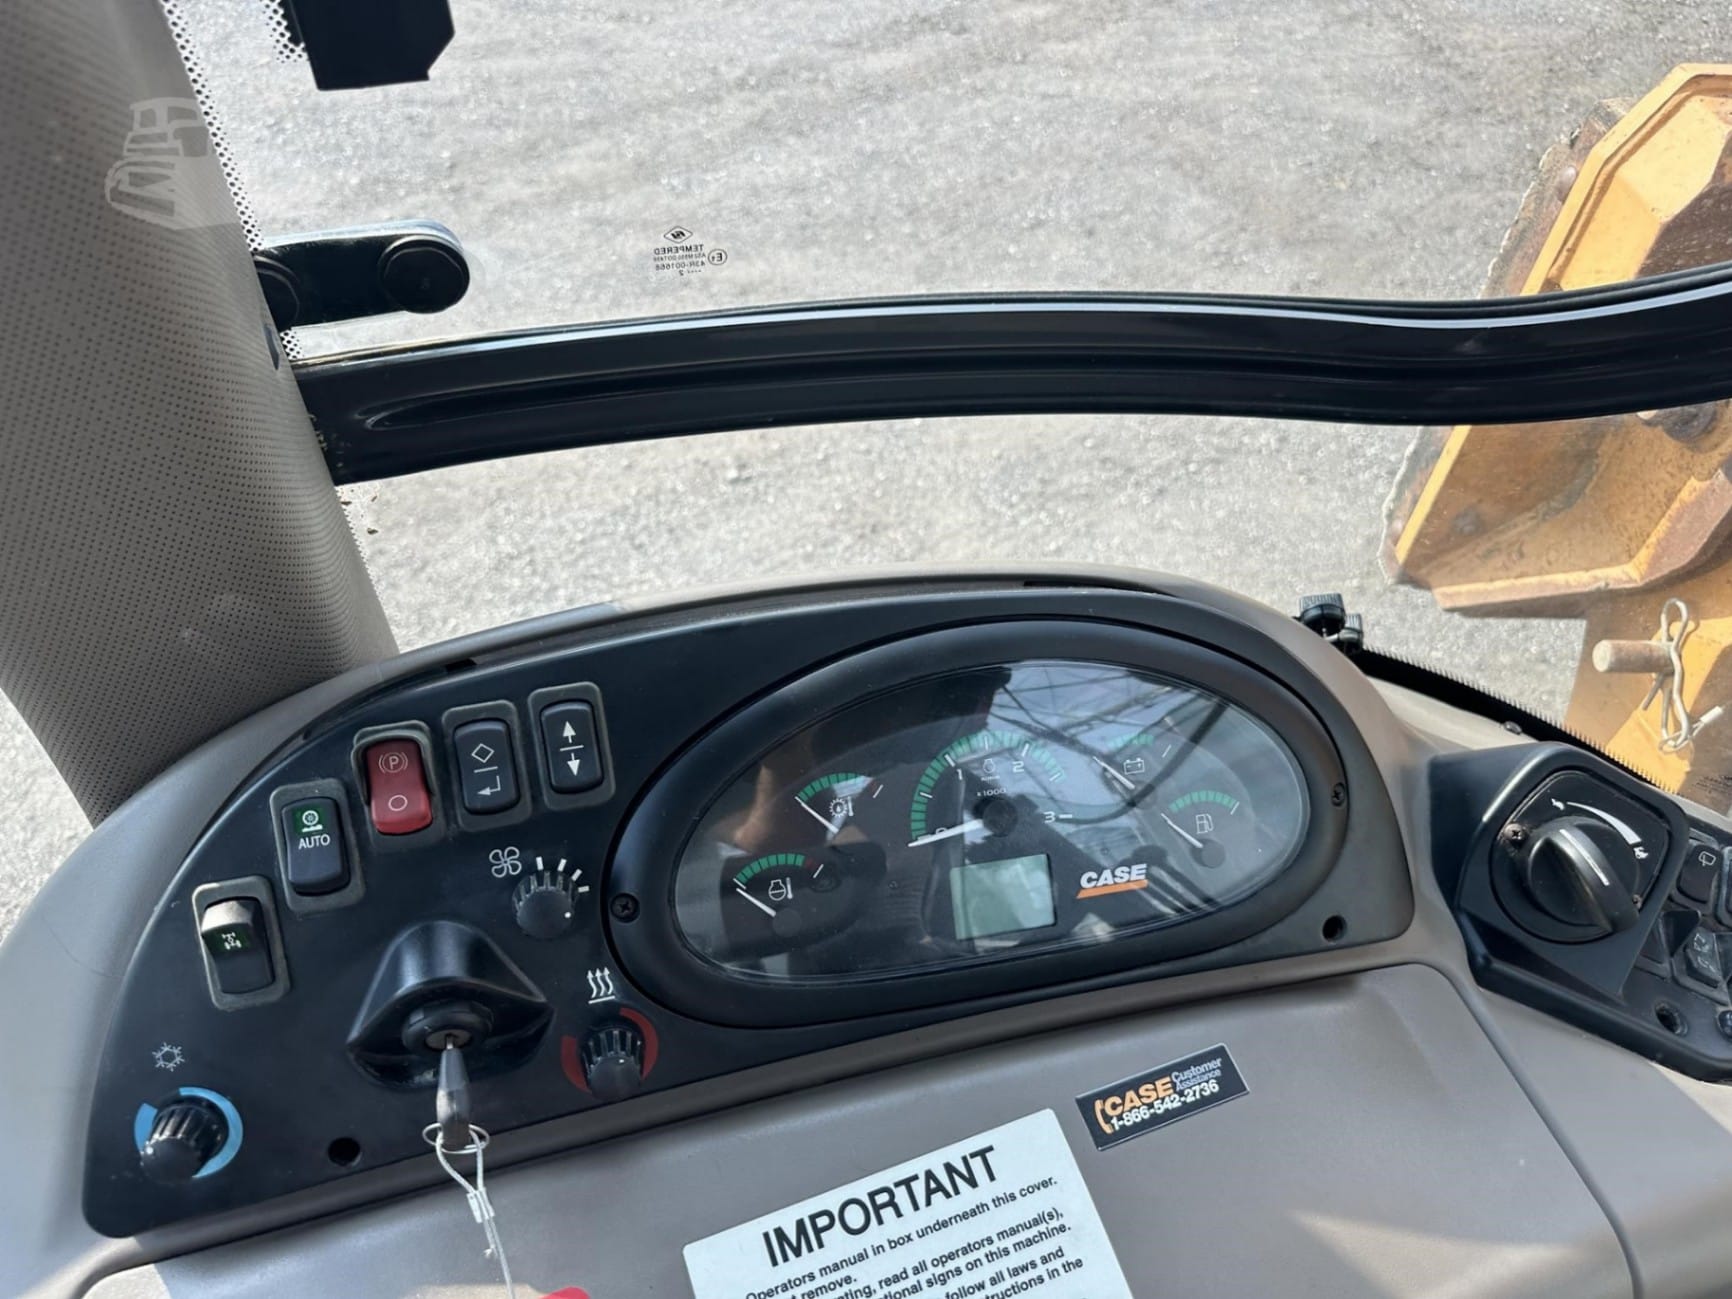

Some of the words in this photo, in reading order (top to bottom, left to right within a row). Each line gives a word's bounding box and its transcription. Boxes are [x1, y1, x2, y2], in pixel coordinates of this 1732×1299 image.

[956, 768, 963, 780] 1
[1012, 761, 1025, 773] 2
[1043, 811, 1056, 824] 3
[298, 834, 330, 849] AUTO
[1079, 863, 1148, 890] CASE
[1171, 1057, 1222, 1083] Customer
[1176, 1069, 1222, 1092] Assistance
[1103, 1076, 1174, 1117] CASE
[1110, 1079, 1220, 1131] 1-866-542-2736
[762, 1145, 997, 1267] IMPORTANT
[819, 1248, 869, 1277] manual
[871, 1243, 886, 1257] in
[887, 1231, 914, 1250] box
[915, 1201, 990, 1239] underneath
[992, 1191, 1017, 1208] this
[1019, 1176, 1058, 1198] cover.
[878, 1267, 909, 1289] read
[911, 1260, 928, 1276] all
[931, 1235, 994, 1268] operators
[997, 1207, 1064, 1242] manual(s),
[925, 1266, 962, 1288] signs
[965, 1258, 983, 1271] on
[984, 1246, 1010, 1263] this
[1012, 1222, 1071, 1253] machine.
[945, 1280, 985, 1299] follow
[989, 1270, 1005, 1286] all
[1006, 1259, 1038, 1278] laws
[1039, 1245, 1065, 1265] and
[1046, 1268, 1060, 1280] in
[1061, 1258, 1084, 1274] the
[801, 1275, 857, 1299] remove.
